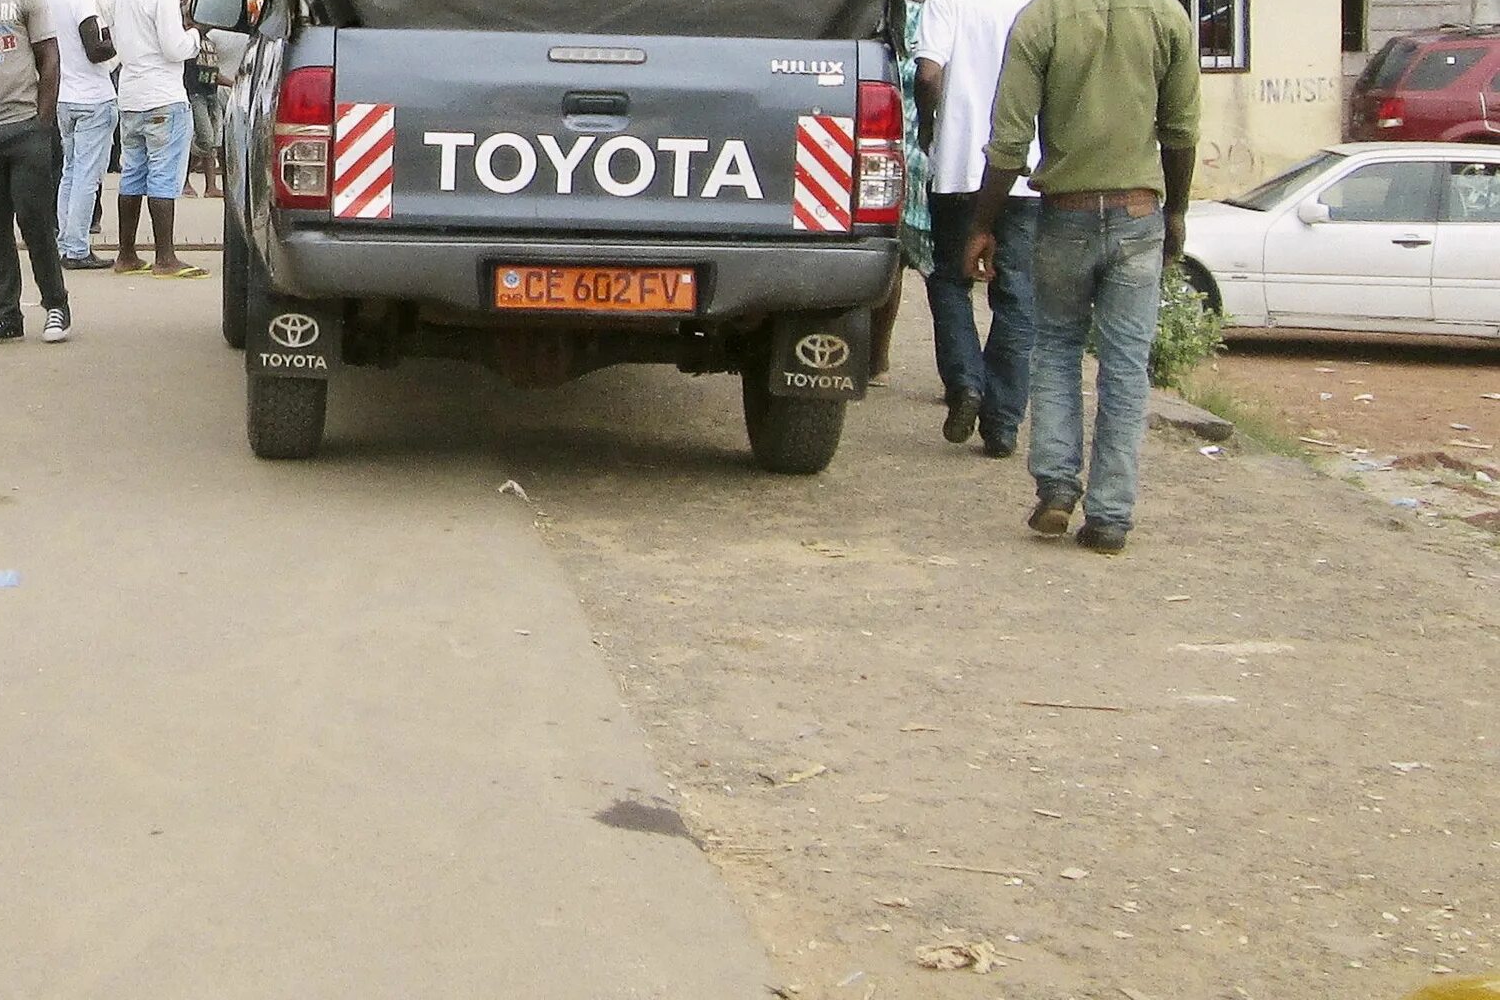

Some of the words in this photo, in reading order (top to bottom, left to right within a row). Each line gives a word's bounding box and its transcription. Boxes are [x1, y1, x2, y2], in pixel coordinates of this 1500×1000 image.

[771, 59, 844, 74] HILUX
[423, 131, 765, 199] TOYOTA
[524, 270, 565, 303] CE
[572, 272, 632, 304] 602
[639, 272, 681, 304] FV
[260, 353, 328, 369] TOYOTA
[783, 371, 854, 390] TOYOTA
